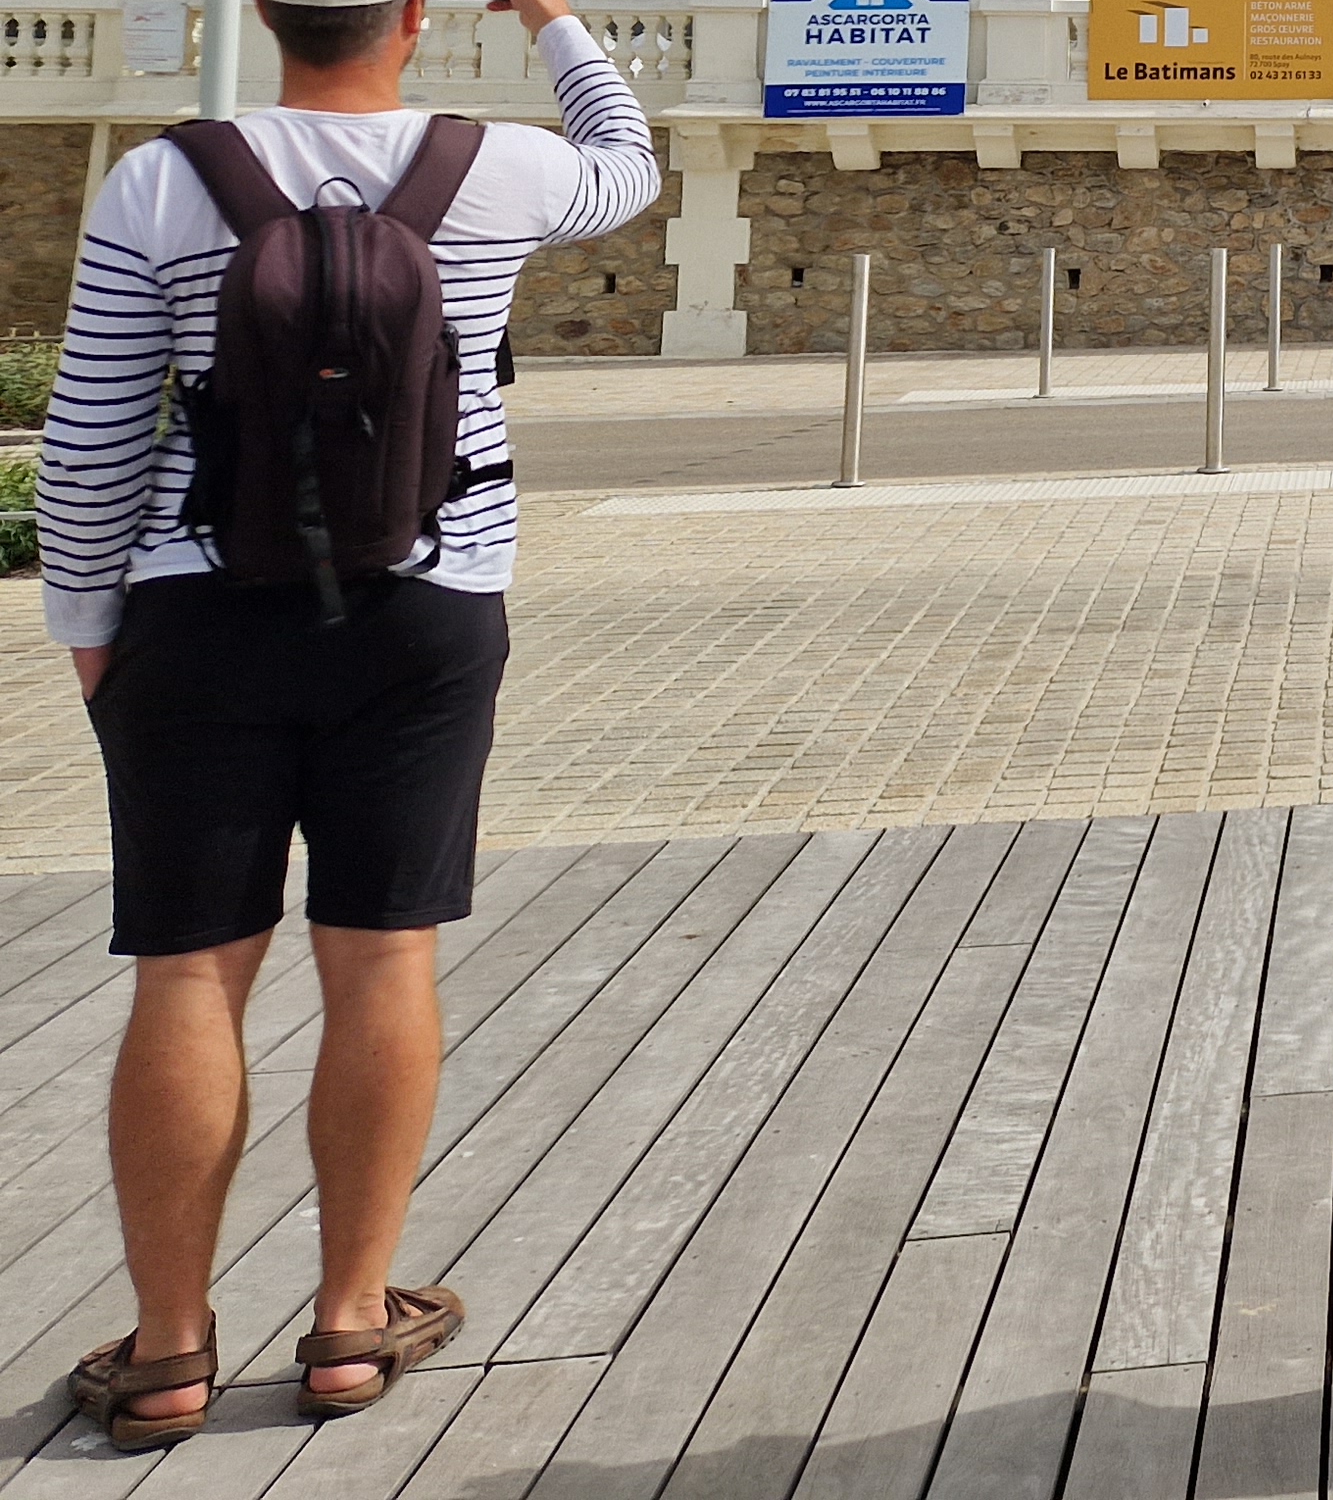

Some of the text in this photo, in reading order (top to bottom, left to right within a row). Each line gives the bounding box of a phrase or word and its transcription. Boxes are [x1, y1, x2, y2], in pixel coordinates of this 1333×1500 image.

[1250, 0, 1283, 11] BÉTON
[806, 13, 930, 26] ASCARGORTA
[1250, 13, 1316, 24] MAÇONNERIE
[1250, 24, 1315, 34] GROS ŒUVRE
[804, 27, 932, 45] HABITAT
[1250, 36, 1322, 46] RESTAURATION
[786, 58, 862, 67] RAVALEMENT
[871, 57, 946, 66] COUVERTURE
[804, 67, 928, 77] PEINTURE INTÉRIEURE
[1104, 61, 1236, 80] Le Batimans
[1249, 70, 1322, 80] 02 43 21 61 33
[783, 88, 800, 97] 07
[887, 87, 900, 96] 10
[902, 87, 912, 96] 11
